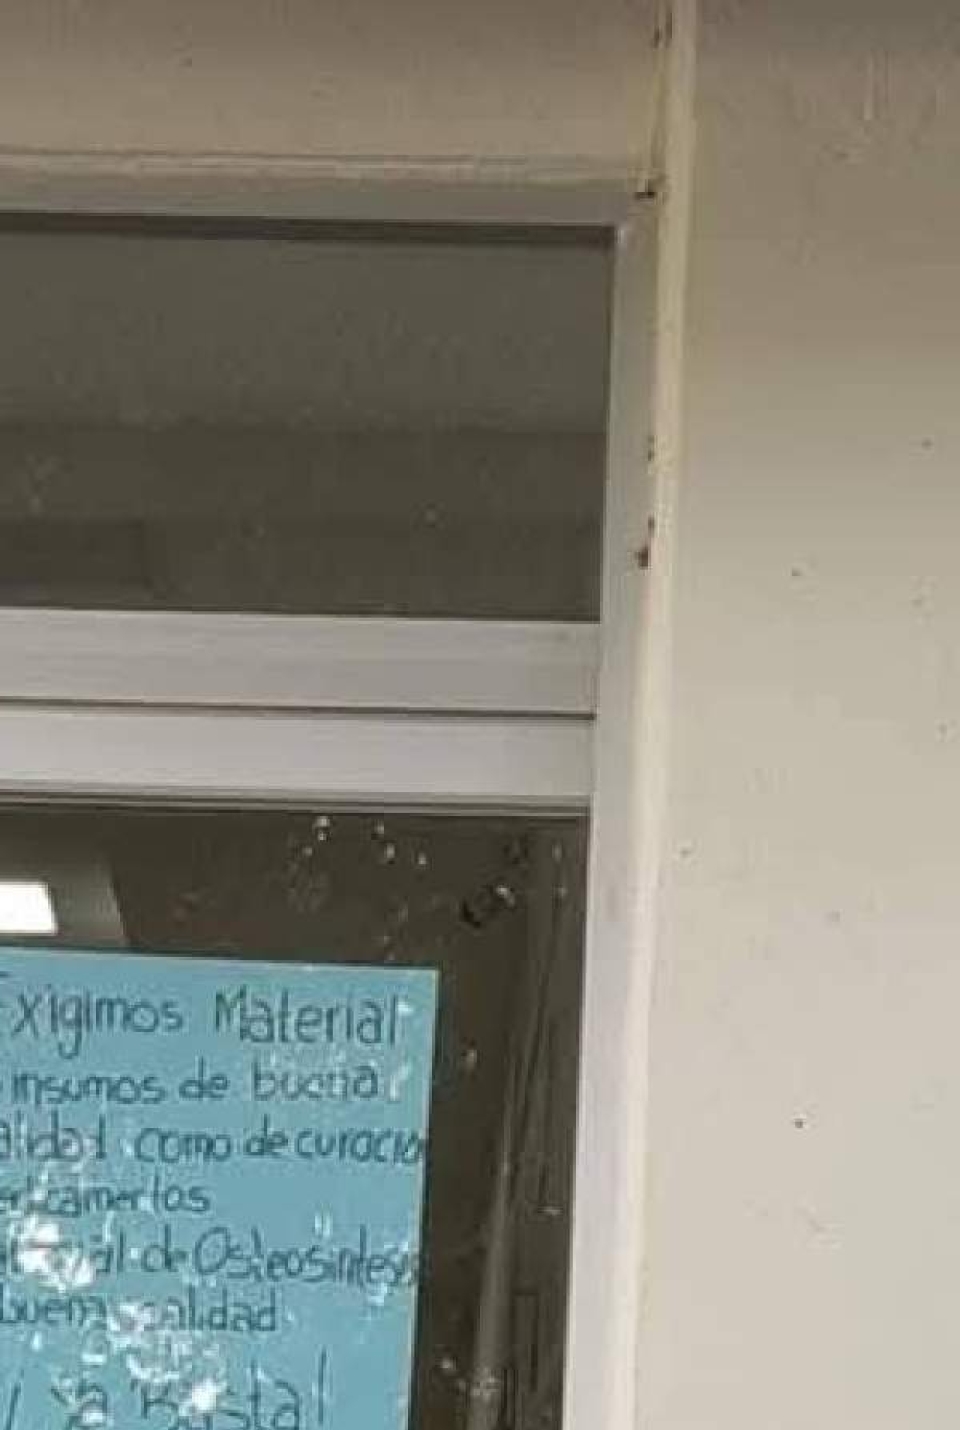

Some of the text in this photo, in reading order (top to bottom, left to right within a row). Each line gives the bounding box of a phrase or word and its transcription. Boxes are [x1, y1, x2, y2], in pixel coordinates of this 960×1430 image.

[215, 985, 398, 1046] Material
[178, 1058, 230, 1099] de
[251, 1060, 379, 1099] buena
[134, 1127, 232, 1164] como
[245, 1113, 289, 1158] de
